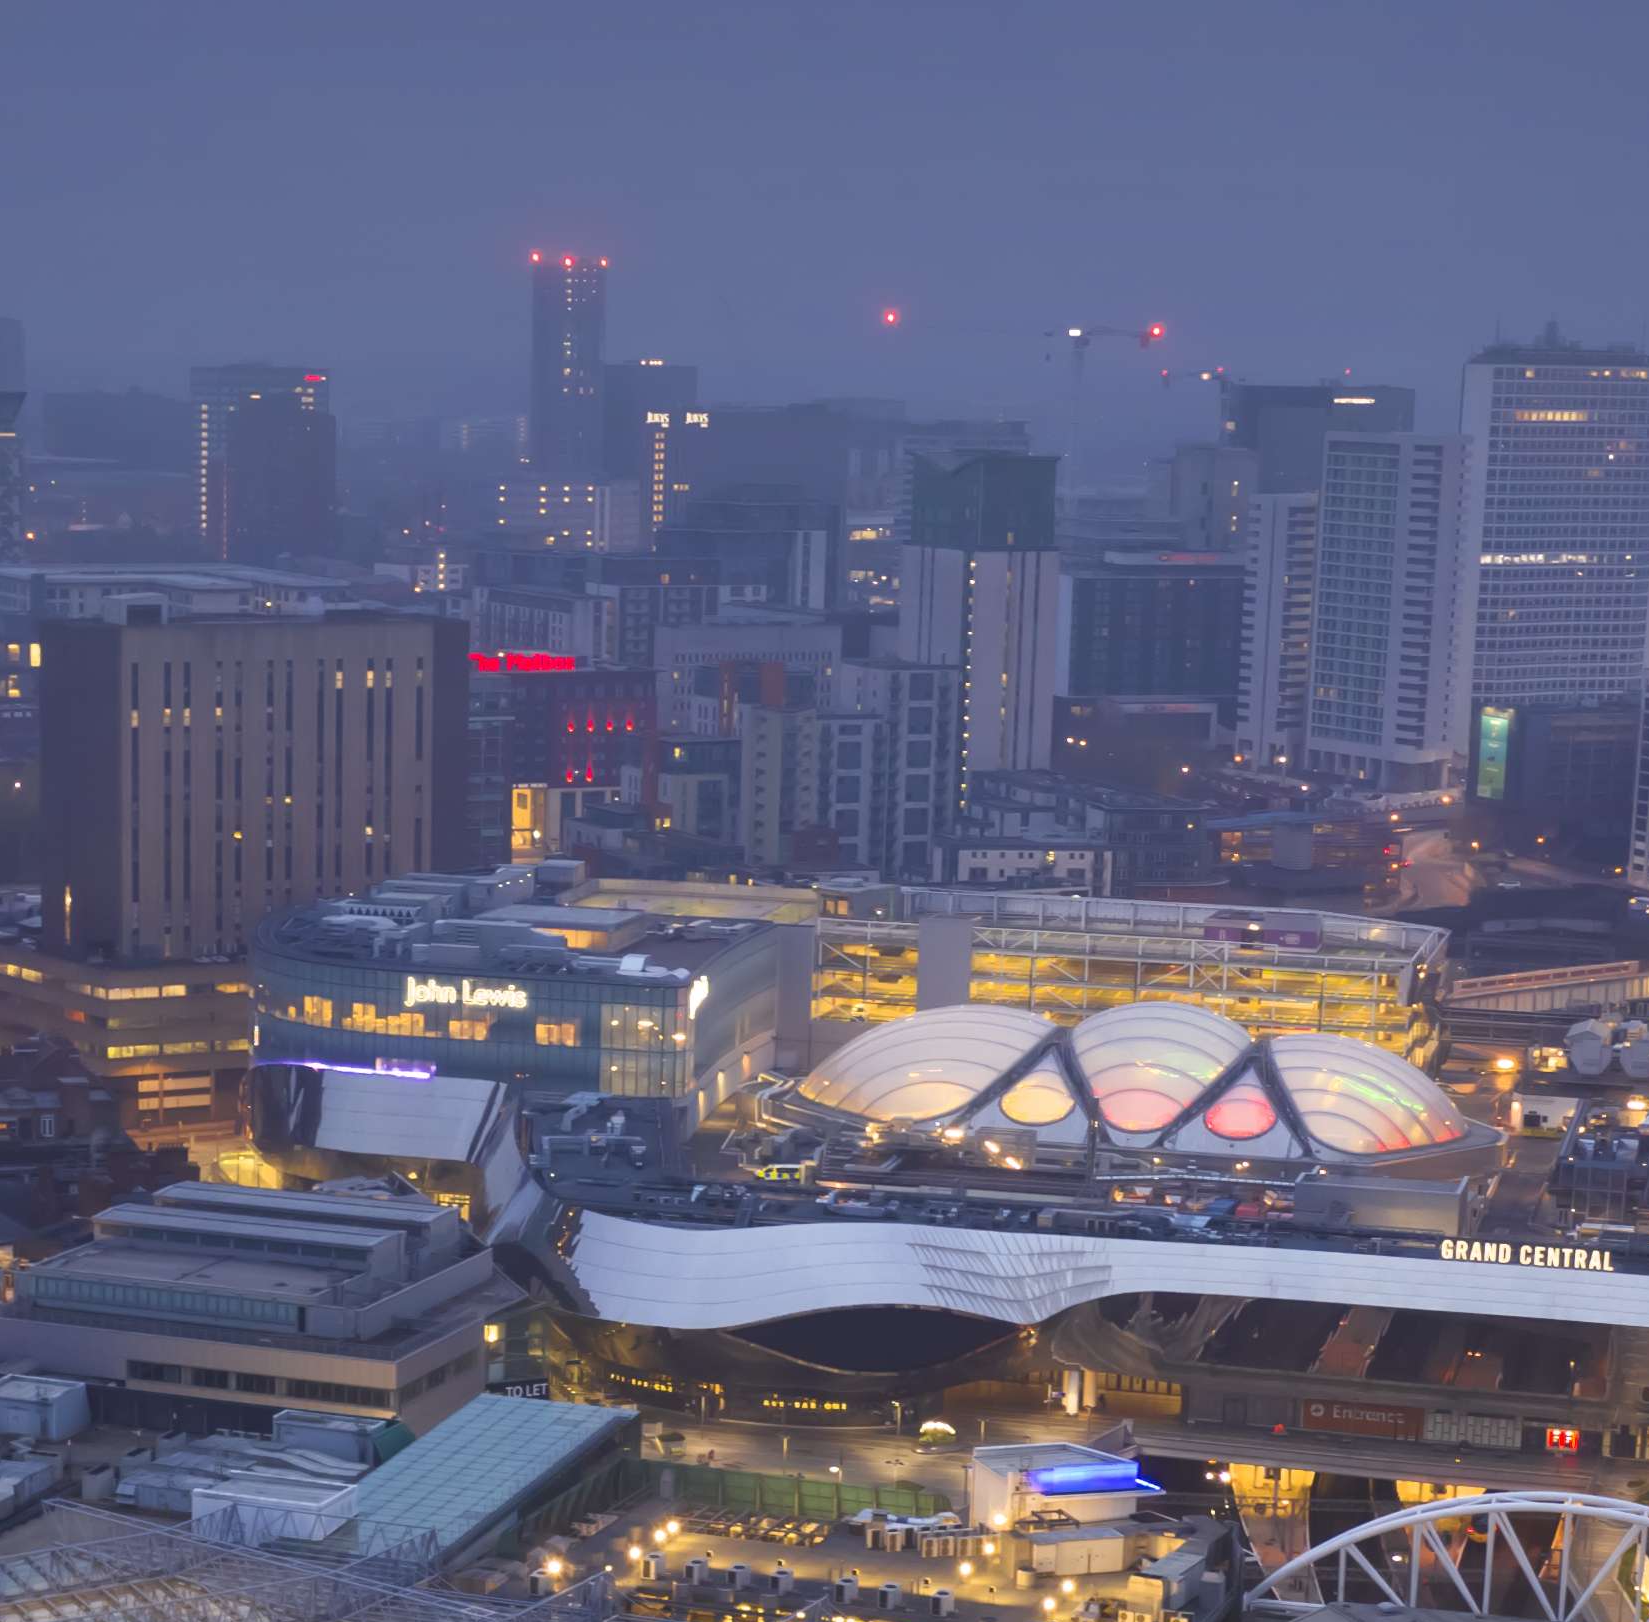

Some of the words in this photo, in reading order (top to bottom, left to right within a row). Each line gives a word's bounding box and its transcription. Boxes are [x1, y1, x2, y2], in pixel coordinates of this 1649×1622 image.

[405, 976, 457, 1008] John
[462, 979, 527, 1009] Lewis
[1441, 1240, 1511, 1264] GRAND
[1519, 1244, 1615, 1271] CENTRAL
[505, 1386, 523, 1398] TO
[526, 1383, 548, 1397] LET
[1332, 1404, 1406, 1424] Entrance
